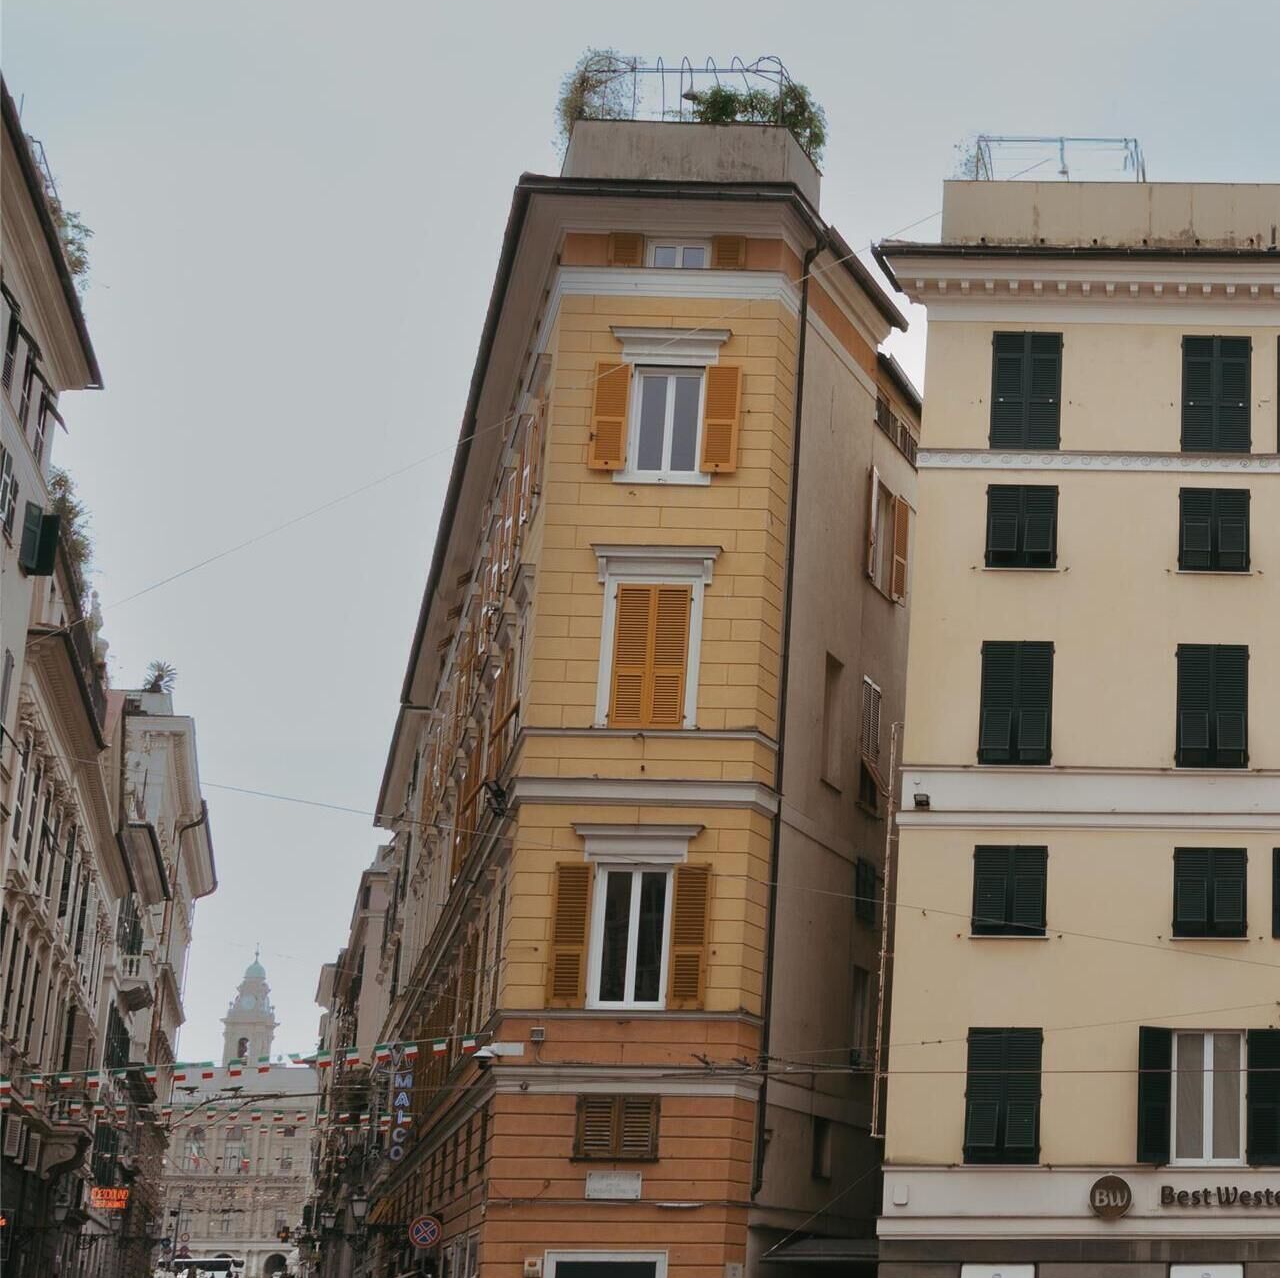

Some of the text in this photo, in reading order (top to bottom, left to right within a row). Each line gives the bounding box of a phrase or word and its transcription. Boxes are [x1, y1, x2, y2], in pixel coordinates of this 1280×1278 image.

[390, 1072, 413, 1161] MAICO
[1095, 1189, 1128, 1206] BW
[1160, 1185, 1211, 1205] Best
